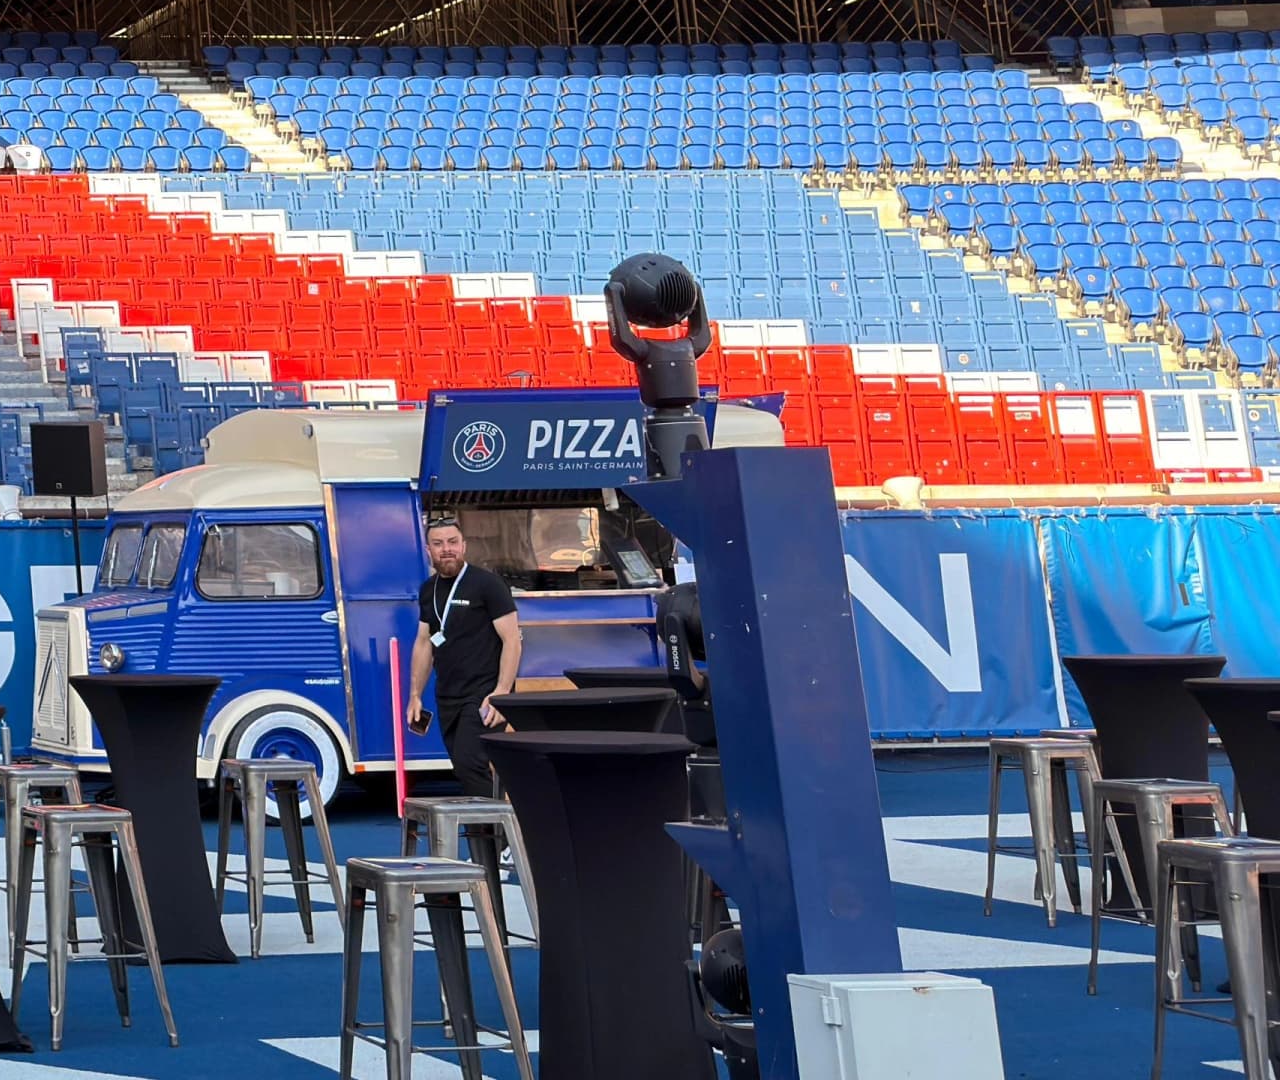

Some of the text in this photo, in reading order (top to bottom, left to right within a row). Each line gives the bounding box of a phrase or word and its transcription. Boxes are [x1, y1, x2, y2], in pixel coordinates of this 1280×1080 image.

[463, 423, 498, 436] PARIS
[526, 418, 643, 459] PIZZA
[523, 461, 644, 470] PARIS SAINT-GERMAIN
[671, 645, 680, 670] BOSCH
